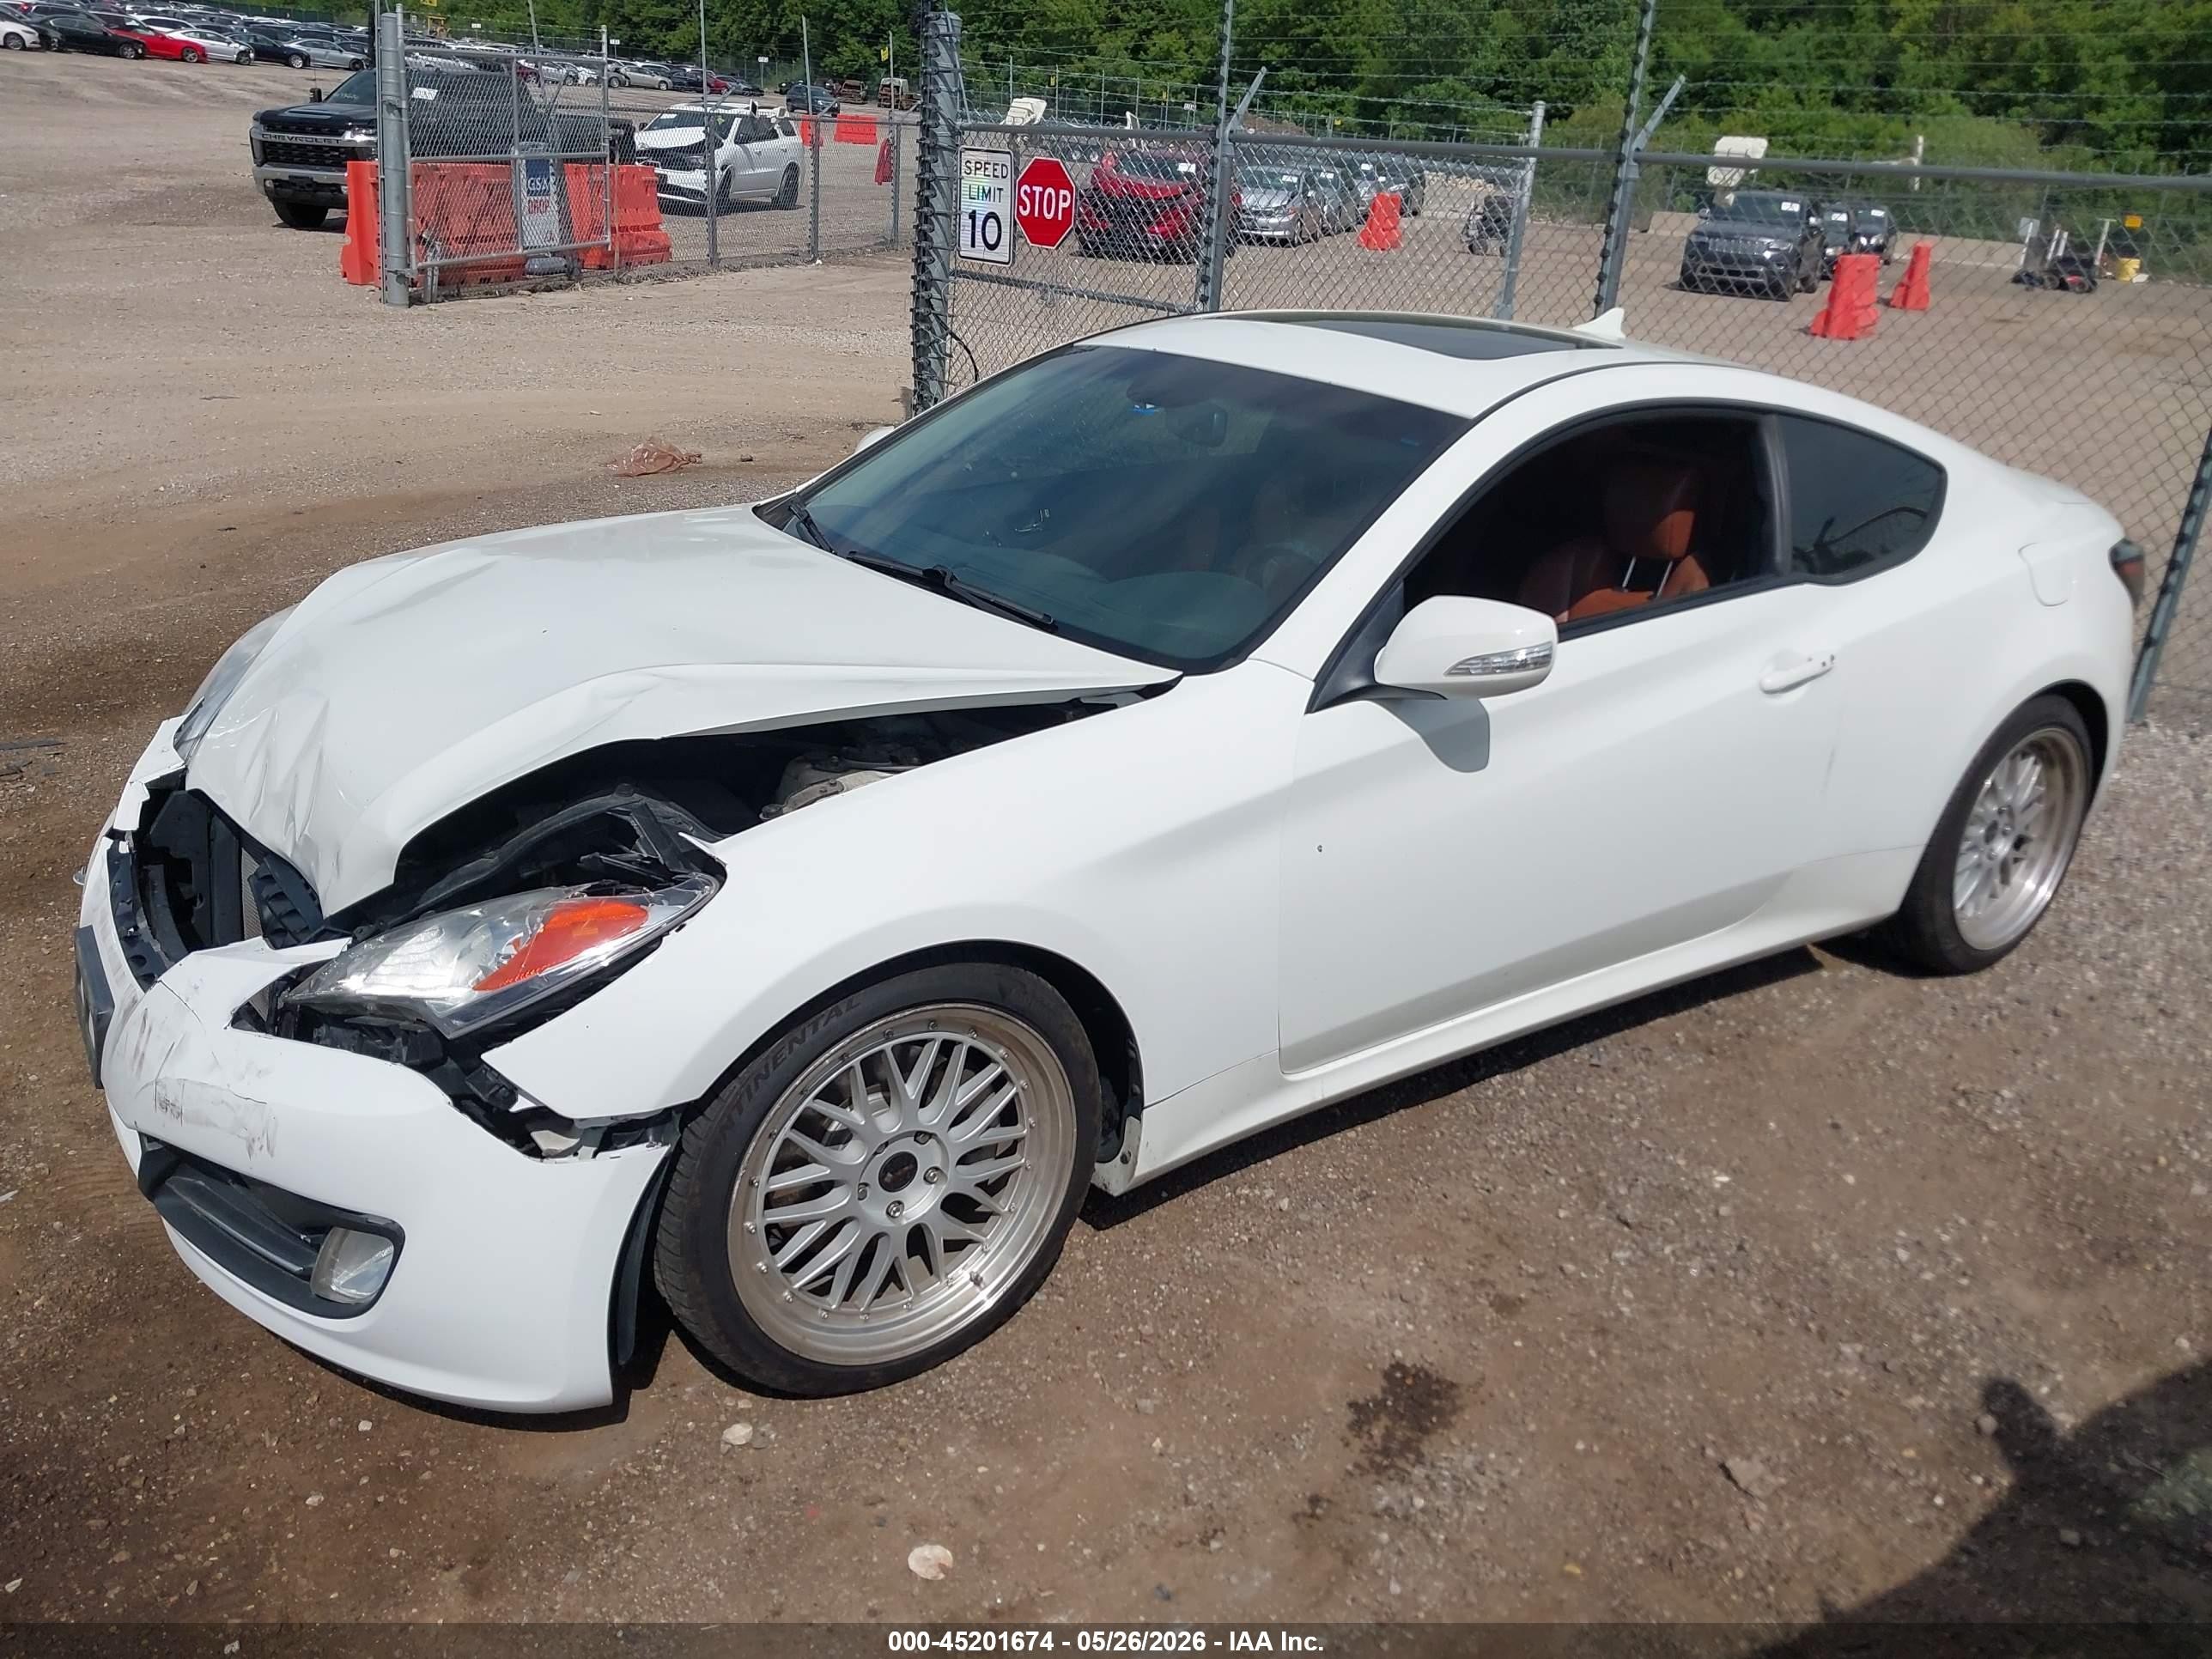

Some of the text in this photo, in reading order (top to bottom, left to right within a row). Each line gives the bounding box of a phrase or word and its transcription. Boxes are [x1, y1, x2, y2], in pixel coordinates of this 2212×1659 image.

[261, 133, 343, 145] CHEVROLET
[963, 160, 1009, 179] SPEED
[968, 184, 1005, 204] LIMIT
[1018, 184, 1073, 222] STOP
[968, 209, 1003, 252] 10
